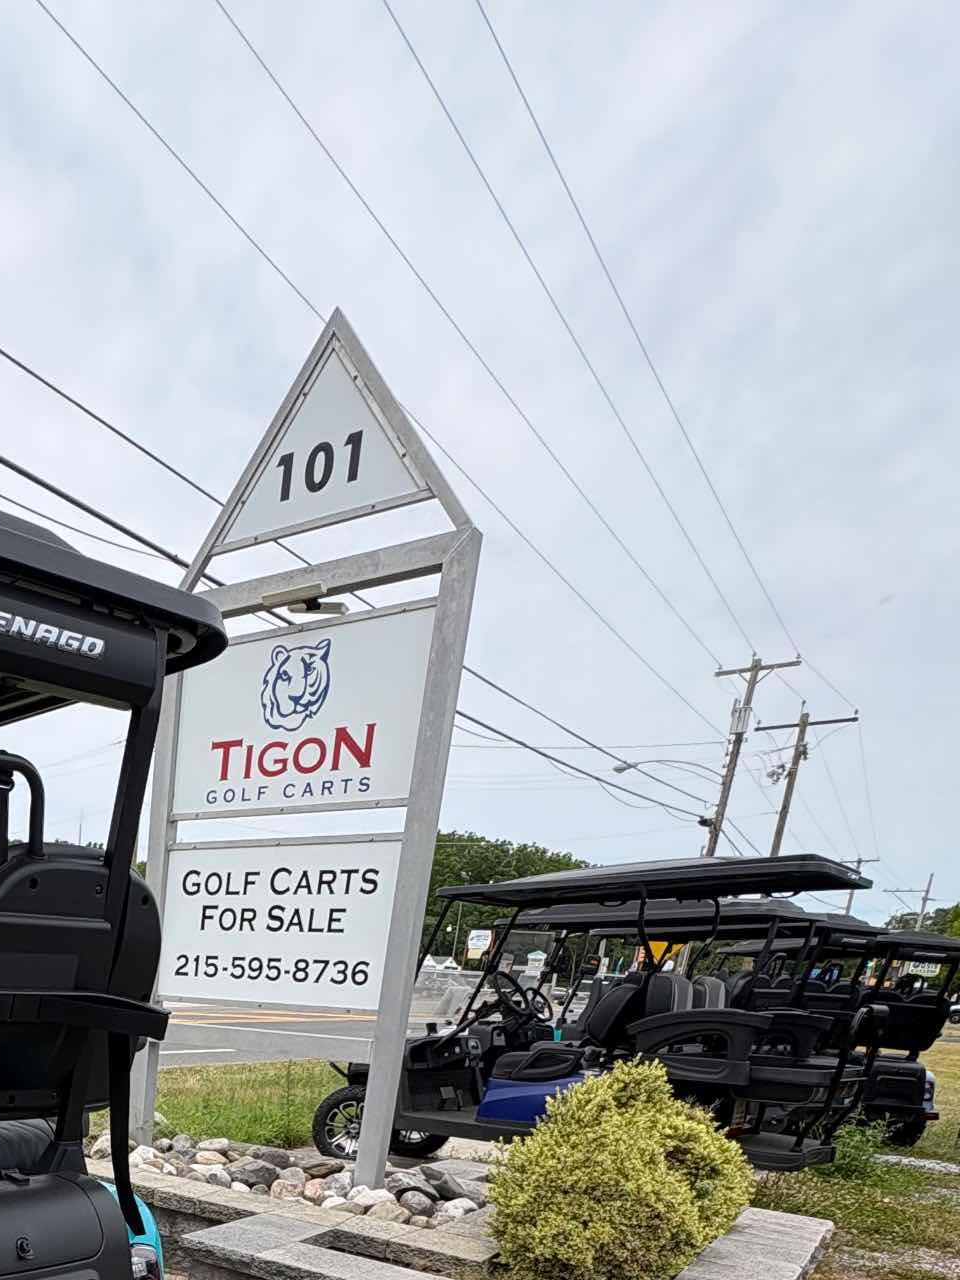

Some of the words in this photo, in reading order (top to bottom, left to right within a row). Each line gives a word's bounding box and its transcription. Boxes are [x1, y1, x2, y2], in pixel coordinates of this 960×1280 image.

[276, 430, 363, 502] 101
[211, 723, 376, 781] TIGON
[206, 786, 268, 805] GOLF
[283, 777, 371, 799] CARTS
[182, 870, 260, 896] GOLF
[270, 867, 379, 895] CARTS
[200, 905, 257, 932] FOR
[266, 904, 347, 933] SALE
[175, 954, 370, 985] 215-595-8736
